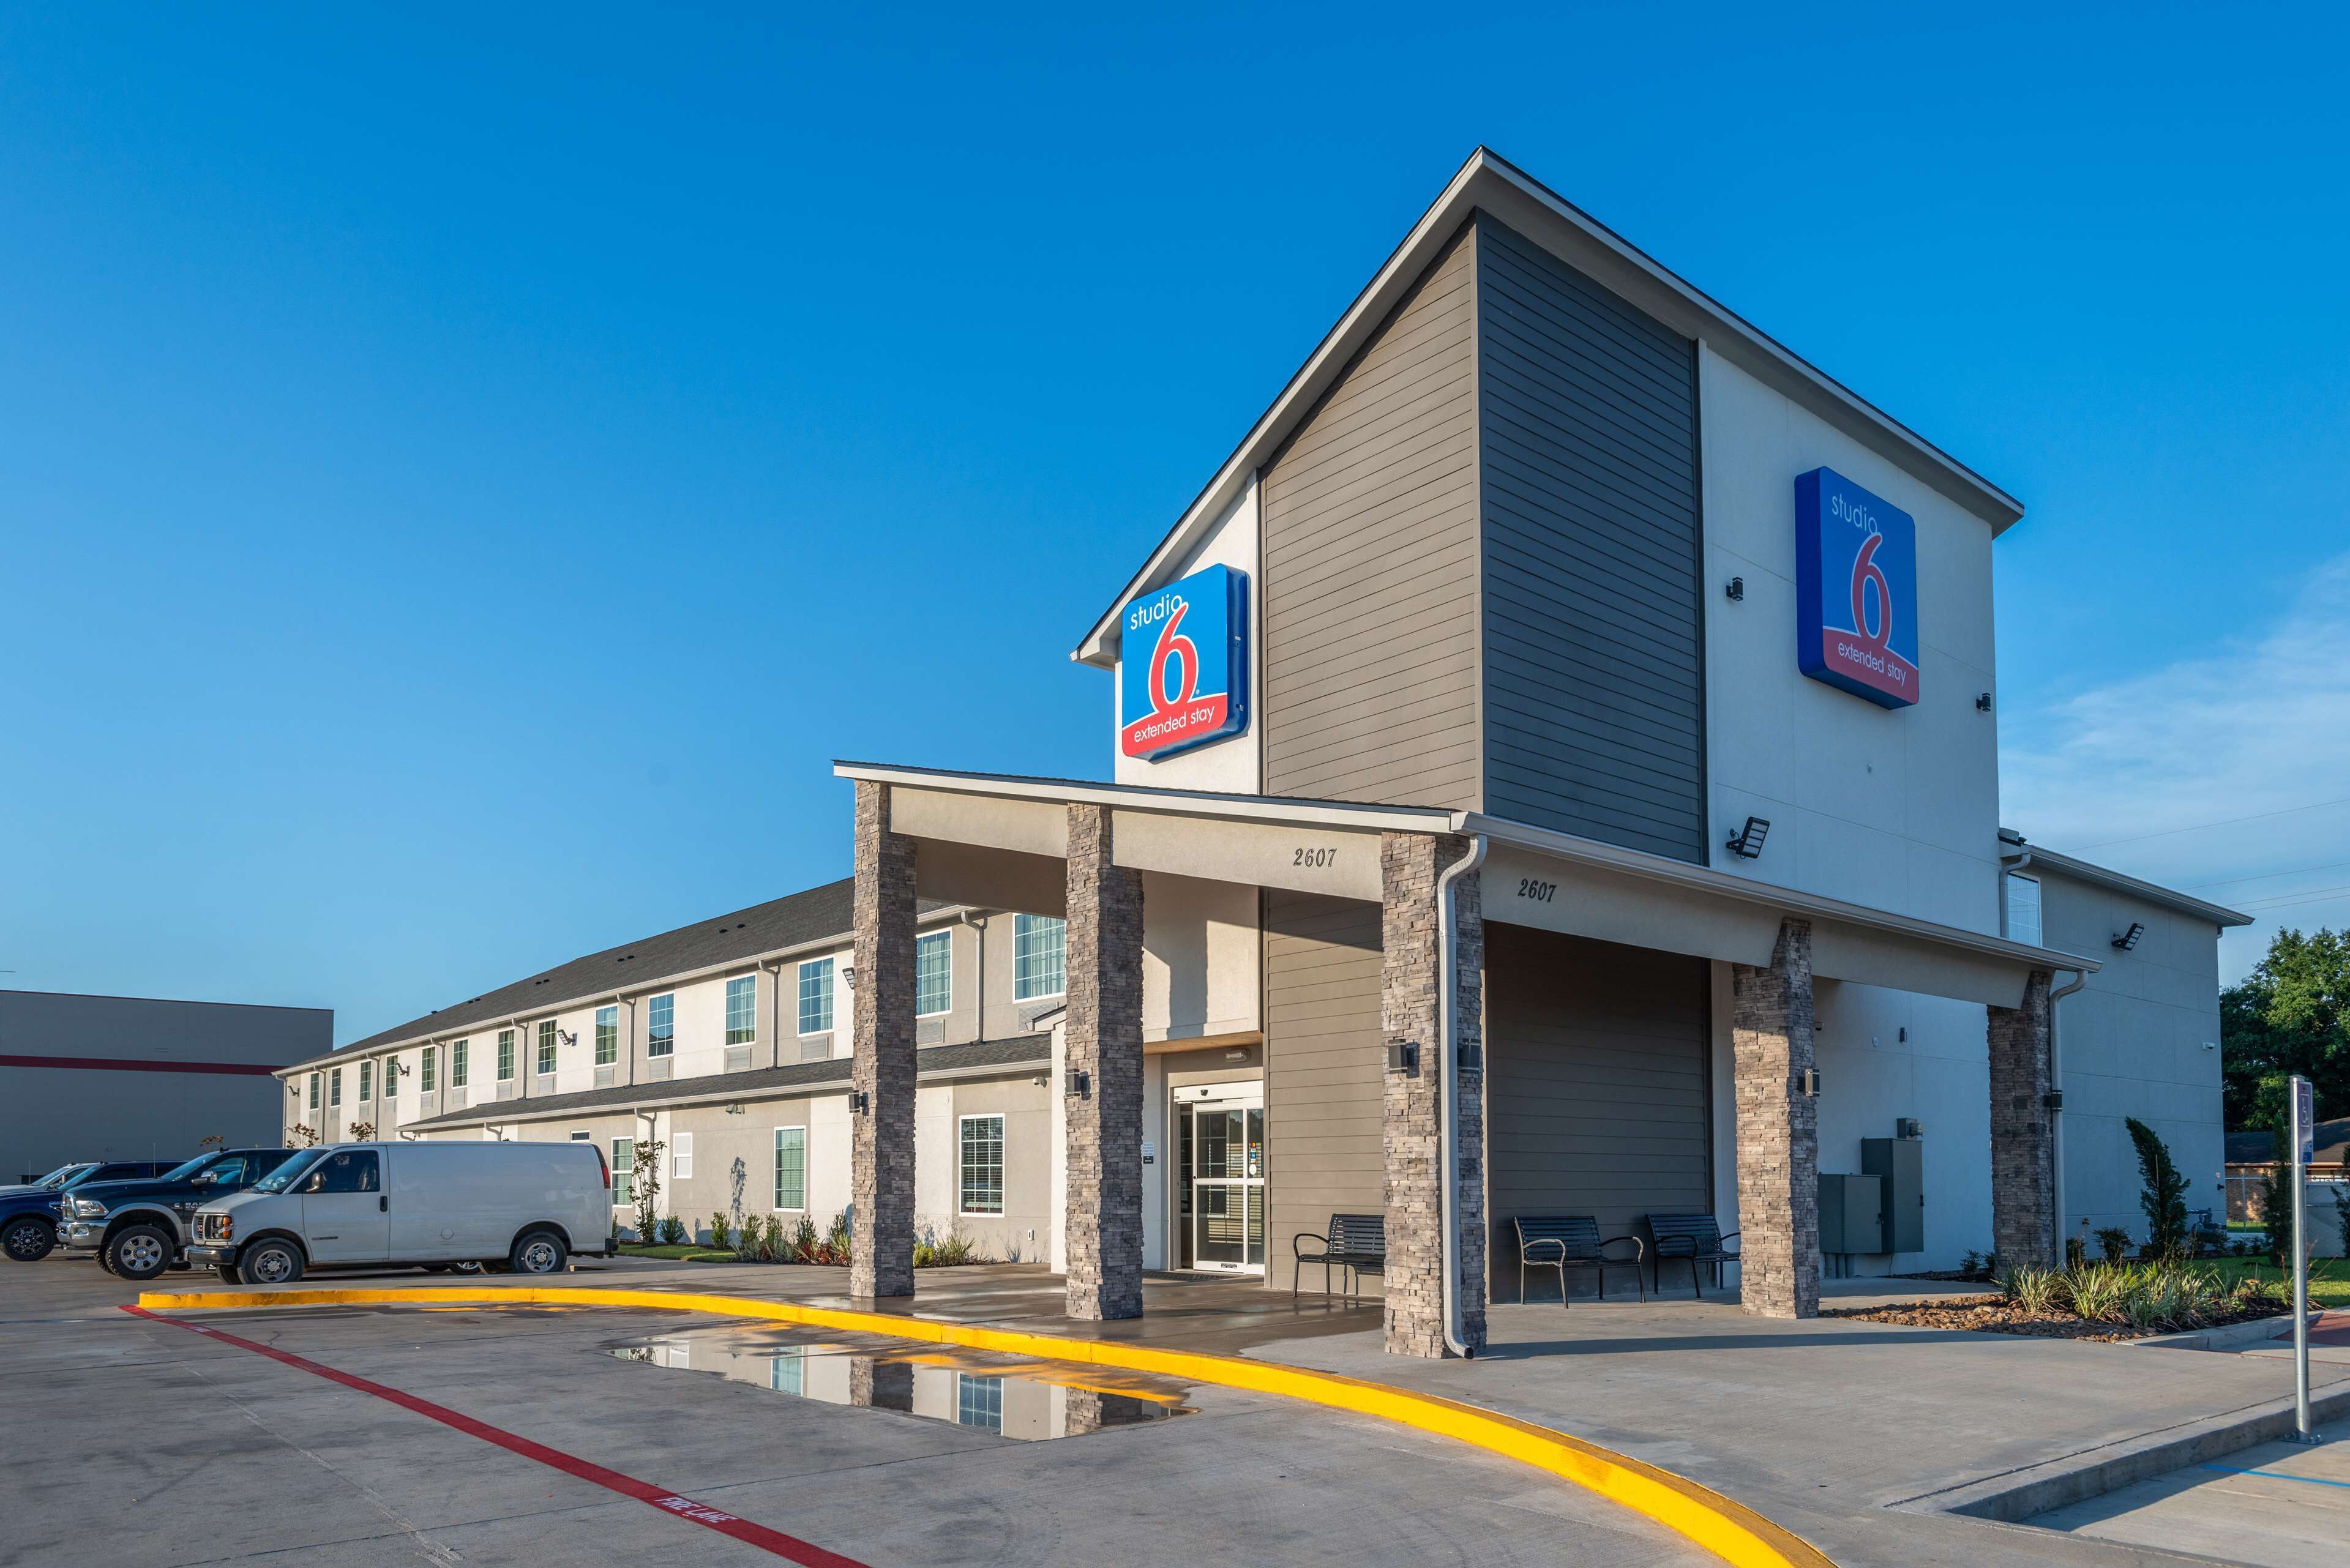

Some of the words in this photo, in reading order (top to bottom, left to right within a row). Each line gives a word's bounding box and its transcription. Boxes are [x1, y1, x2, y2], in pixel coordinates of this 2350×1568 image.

[1832, 493, 1877, 534] studio
[1850, 531, 1892, 649] 6
[1130, 594, 1182, 630] studio
[1148, 601, 1199, 712] 6
[1838, 643, 1885, 674] extended
[1887, 662, 1906, 687] stay
[1134, 711, 1186, 743] extended
[1191, 706, 1215, 725] stay
[1293, 848, 1337, 867] 2607
[1517, 878, 1557, 903] 2607
[654, 1497, 702, 1510] FIRE
[684, 1507, 739, 1523] LANE
